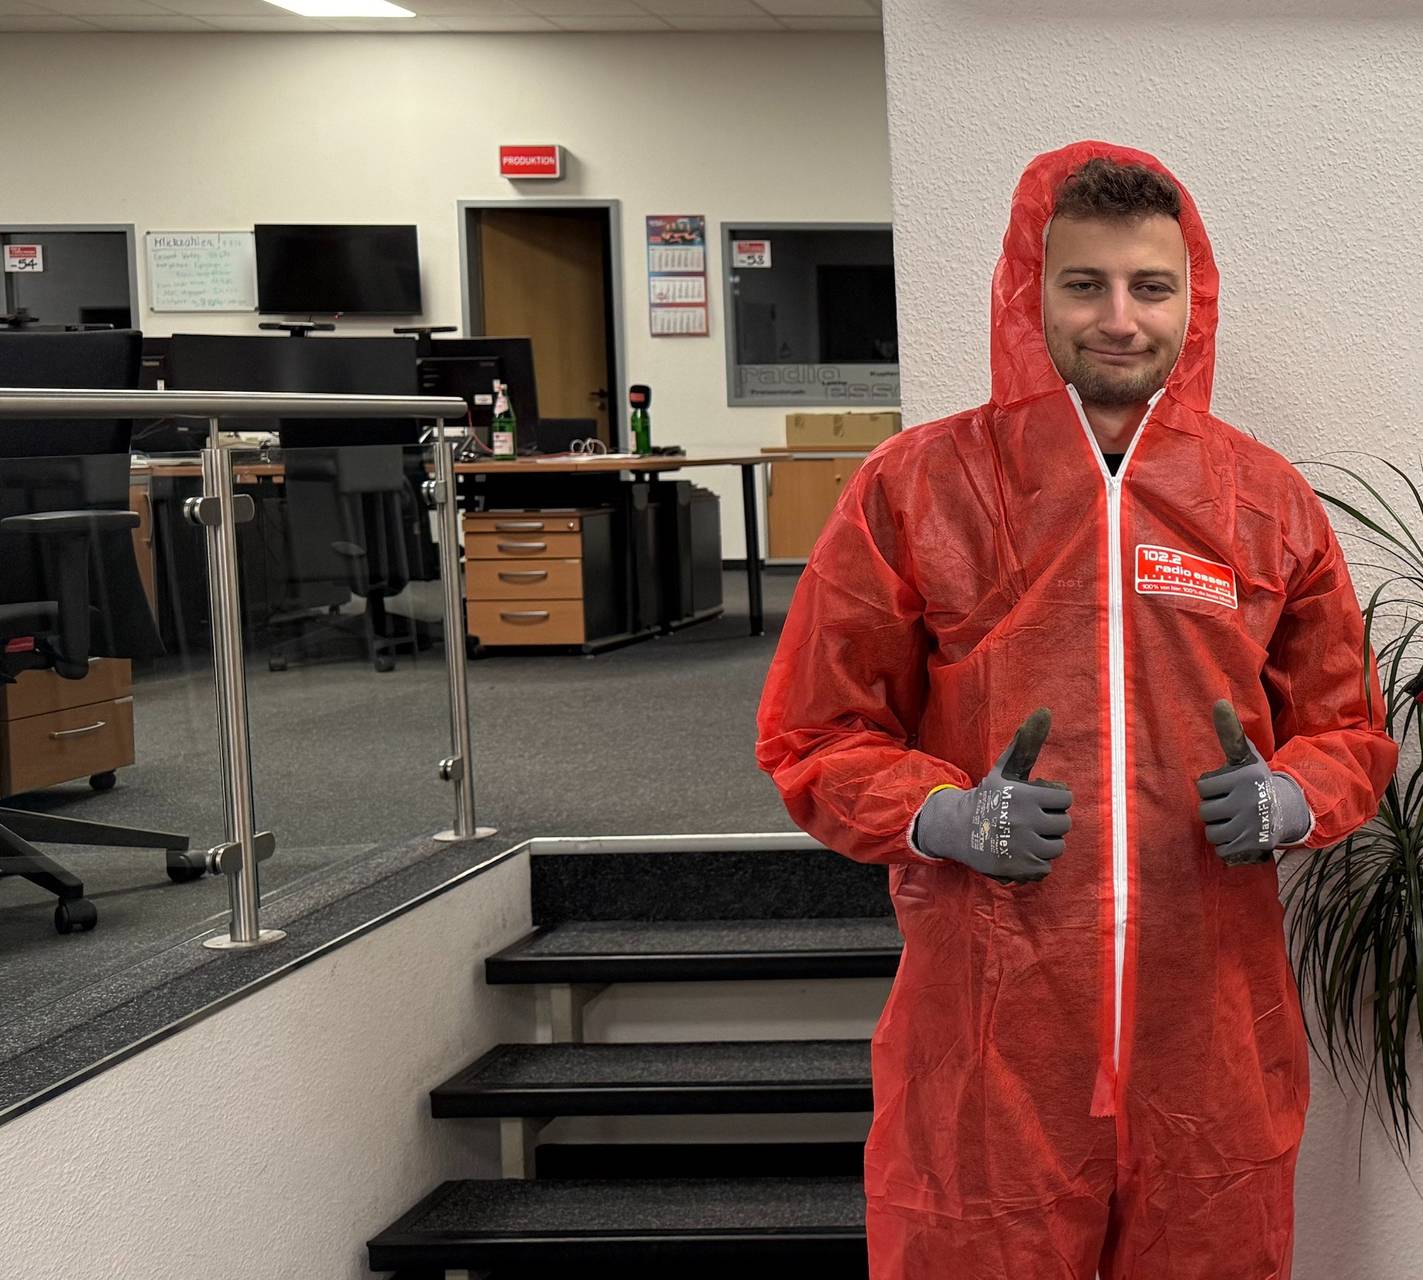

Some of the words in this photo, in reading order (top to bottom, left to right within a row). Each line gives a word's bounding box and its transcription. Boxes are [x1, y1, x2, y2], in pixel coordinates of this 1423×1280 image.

[502, 156, 555, 166] PRODUKTION
[740, 364, 841, 385] radio
[1143, 550, 1182, 565] 102.2
[1155, 564, 1192, 577] radio
[1193, 572, 1230, 588] essen
[1257, 781, 1270, 843] MaxiFlex
